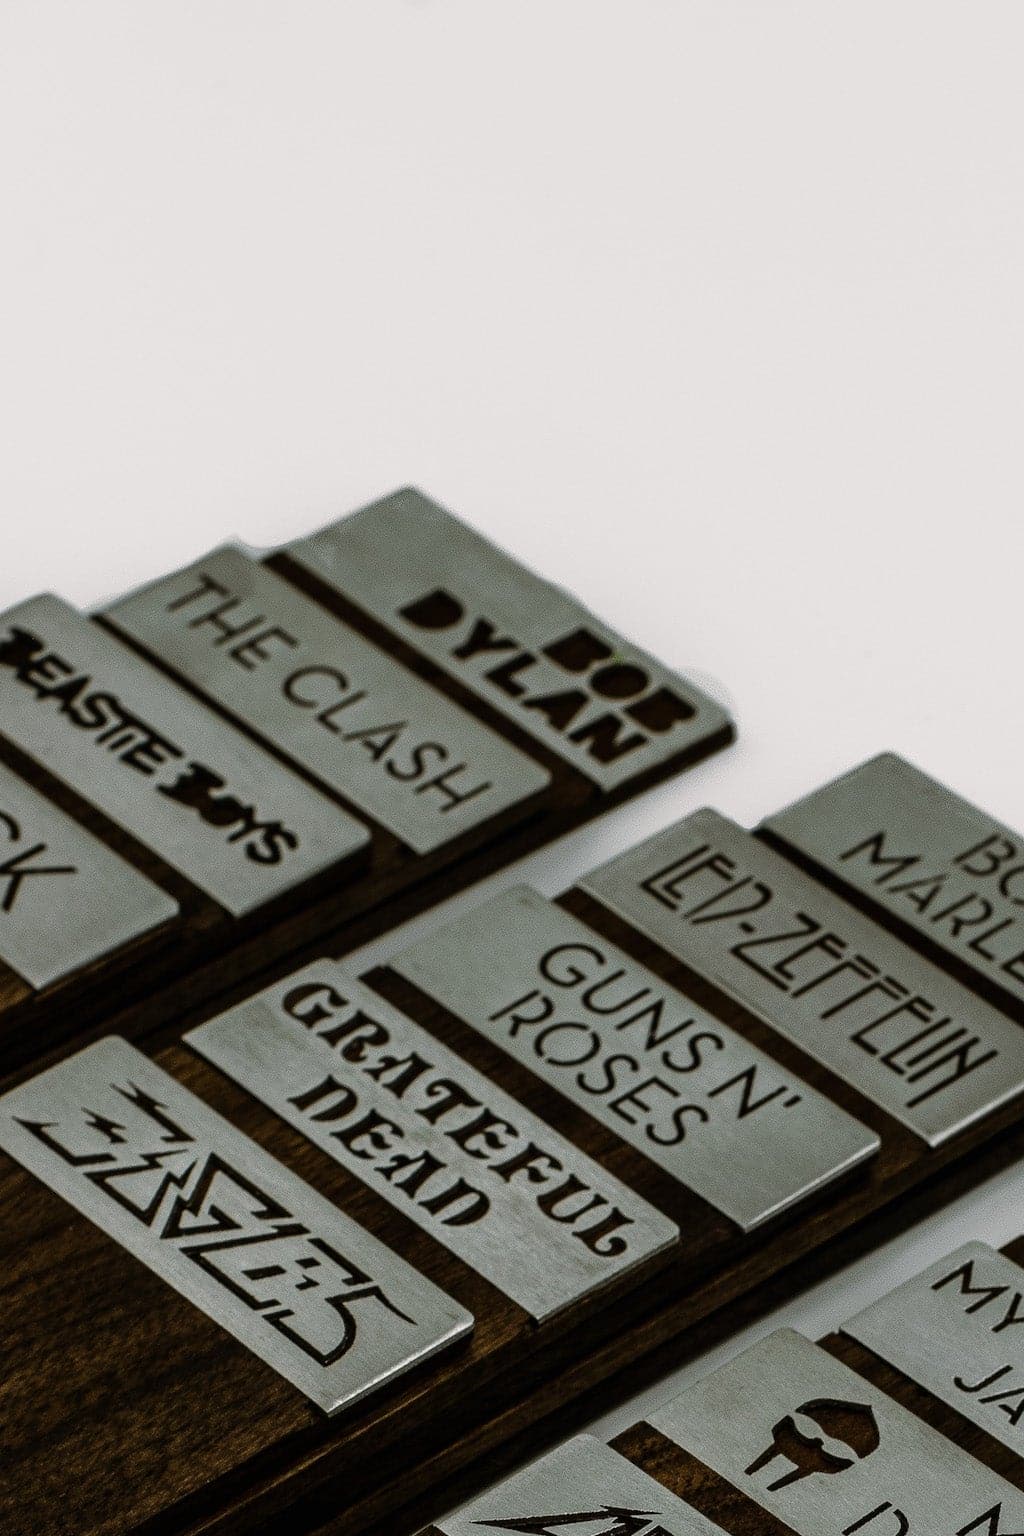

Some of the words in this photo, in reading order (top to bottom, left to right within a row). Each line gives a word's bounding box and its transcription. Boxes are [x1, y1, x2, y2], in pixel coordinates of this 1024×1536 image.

[165, 572, 298, 671] THE
[282, 665, 492, 813] CLASH
[397, 588, 653, 765] DYLAN
[540, 628, 696, 736] BOB
[489, 990, 709, 1146] ROSES
[537, 942, 724, 1073] GUNS
[707, 1064, 803, 1119] N'
[281, 984, 628, 1258] GRATEFUL
[287, 1075, 491, 1227] DEAD
